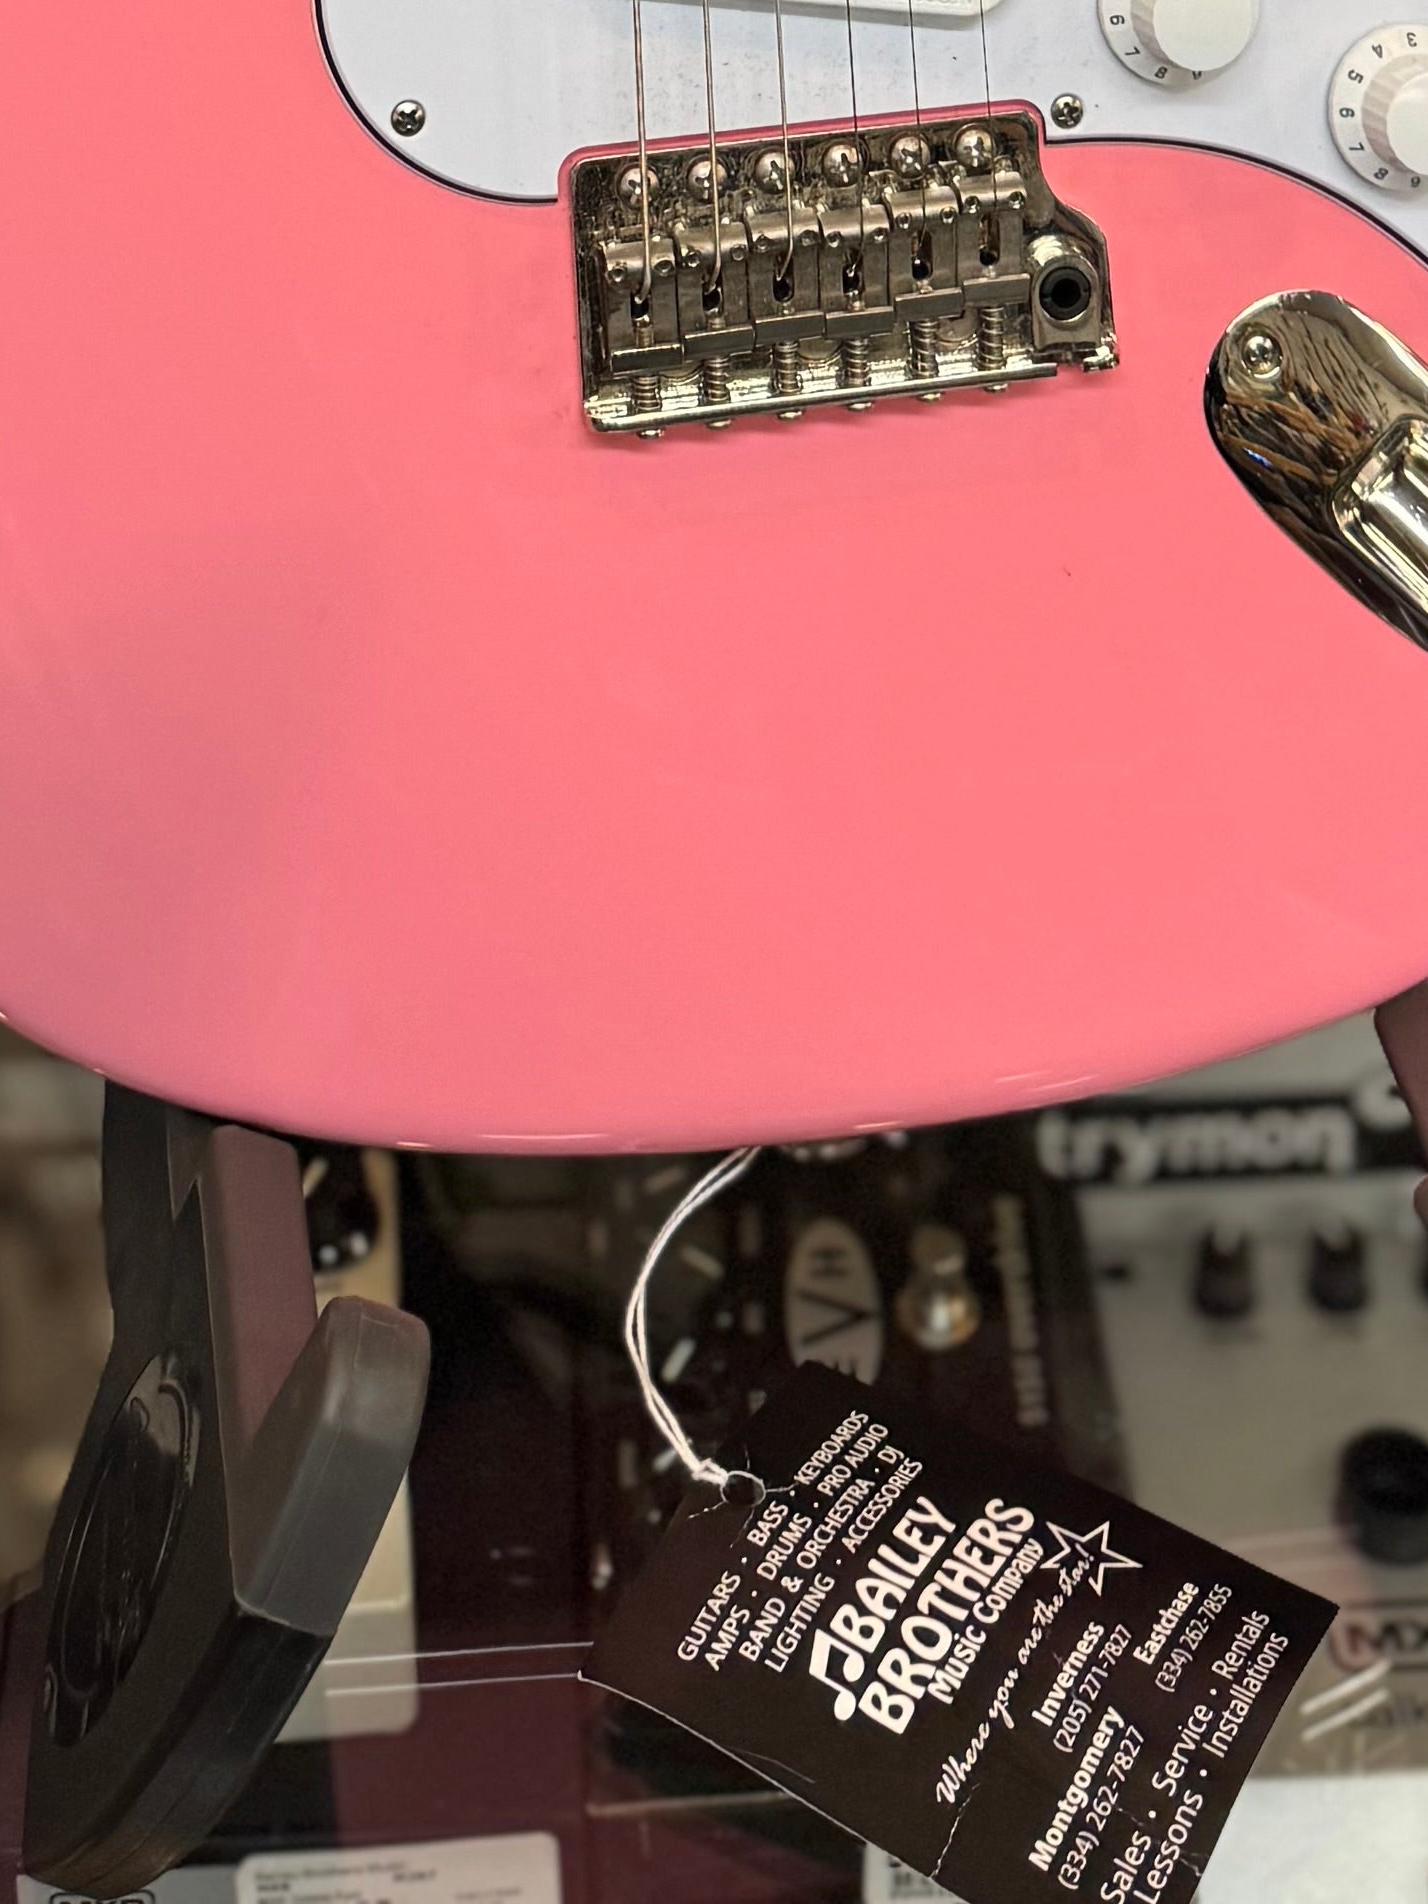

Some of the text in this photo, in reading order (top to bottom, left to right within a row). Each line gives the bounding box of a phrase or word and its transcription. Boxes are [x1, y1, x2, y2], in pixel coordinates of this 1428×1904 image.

[1109, 15, 1125, 25] 6
[1125, 47, 1140, 56] 7
[1154, 66, 1168, 79] 8
[1348, 69, 1364, 83] 5
[1372, 44, 1383, 58] 4
[1406, 32, 1417, 47] 3
[1339, 107, 1355, 118] 6
[1349, 142, 1365, 152] 7
[1373, 168, 1388, 180] 8
[1035, 1106, 1356, 1186] trymon
[798, 1245, 876, 1382] VH
[677, 1410, 869, 1661] GUITARS BASS KEYBOARDS
[703, 1423, 889, 1671] AMPS DRUMS PRO AUDIO
[738, 1445, 905, 1662] BAND & ORCHESTRA DJ
[764, 1457, 924, 1673] LIGHTING ACCESSORIES
[829, 1495, 957, 1654] BAILEY
[857, 1497, 1035, 1735] BROTHERS
[935, 1542, 1095, 1804] Where you are the star!
[1031, 1621, 1105, 1727] Inverness
[1133, 1581, 1199, 1666] Eastchase
[1155, 1583, 1233, 1692] (334) 262-7855
[1053, 1623, 1133, 1753] (205) 271-7827
[1028, 1706, 1126, 1872] Montgomery
[1058, 1725, 1145, 1890] (334) 262-7827
[1100, 1610, 1271, 1904] Sales Service Rentals
[1134, 1632, 1290, 1904] Lessons Installations
